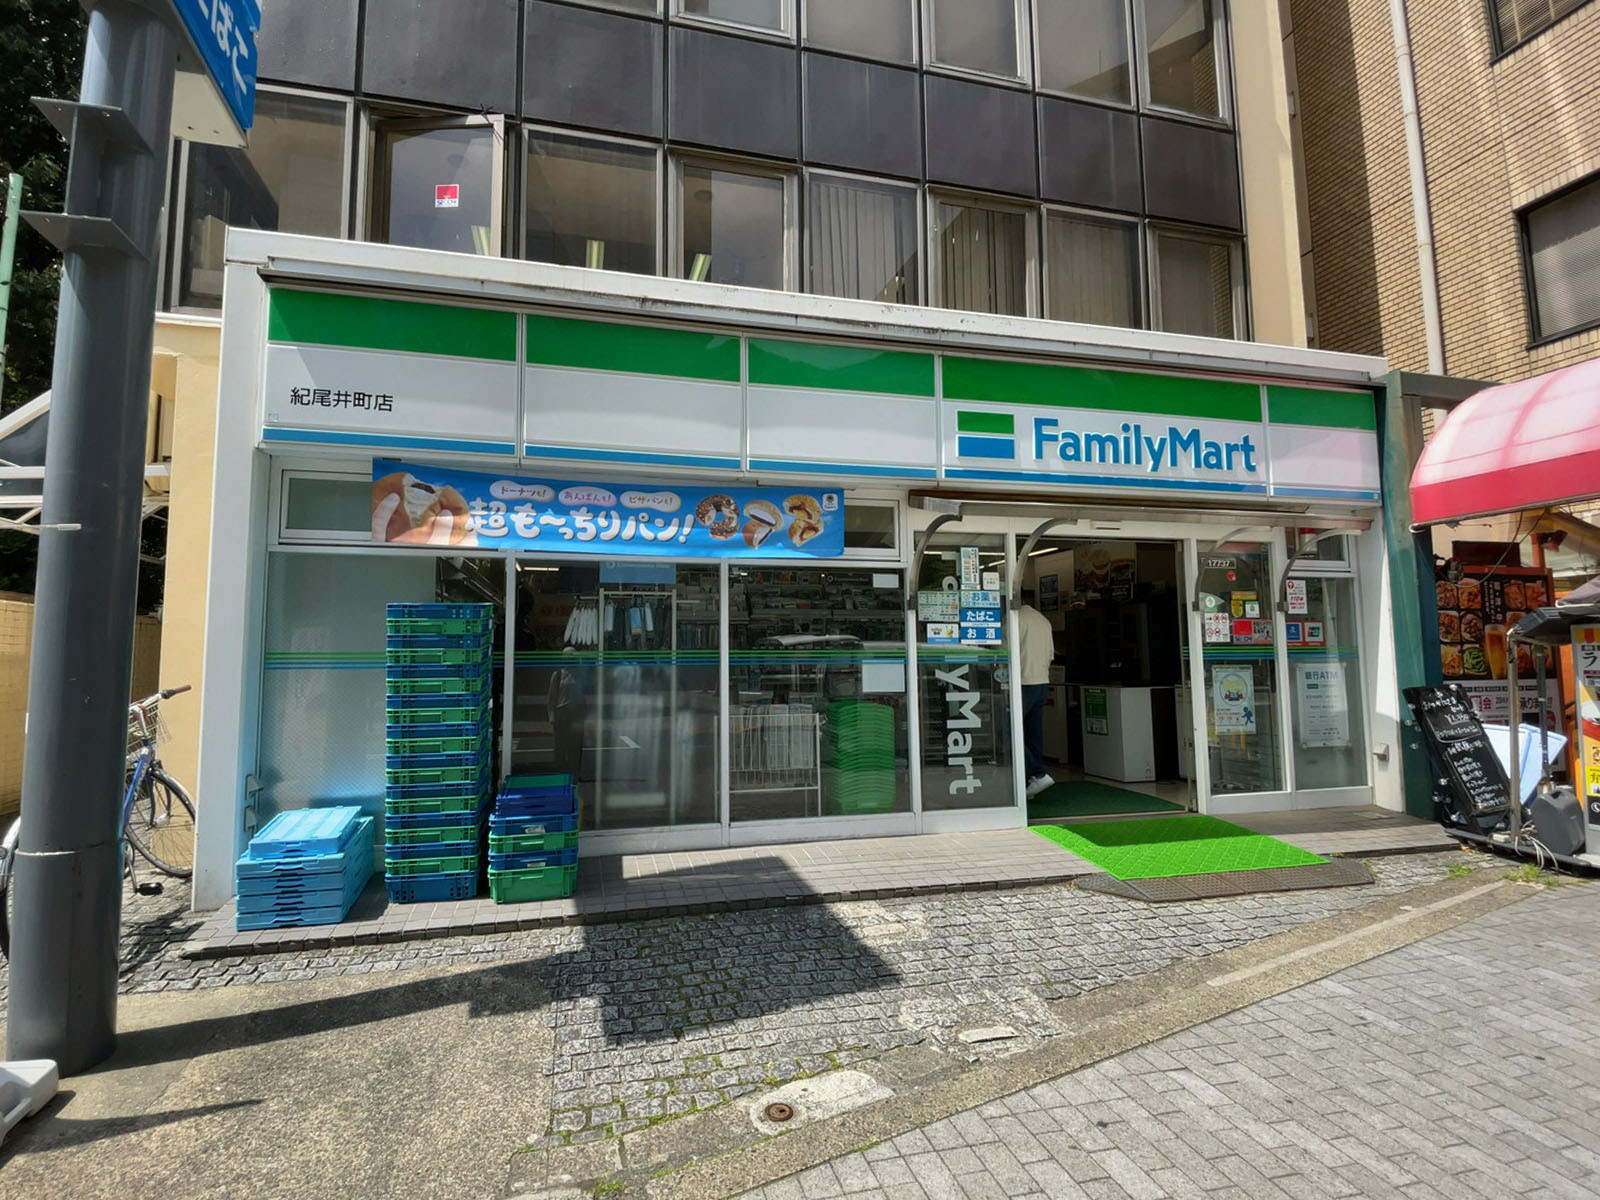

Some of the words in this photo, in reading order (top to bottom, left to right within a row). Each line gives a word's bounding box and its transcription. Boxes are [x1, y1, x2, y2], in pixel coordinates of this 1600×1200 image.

[198, 0, 249, 95] ばこ
[290, 386, 394, 413] 紀尾井町店
[1033, 415, 1257, 473] FamilyMart
[966, 610, 995, 621] たばこ
